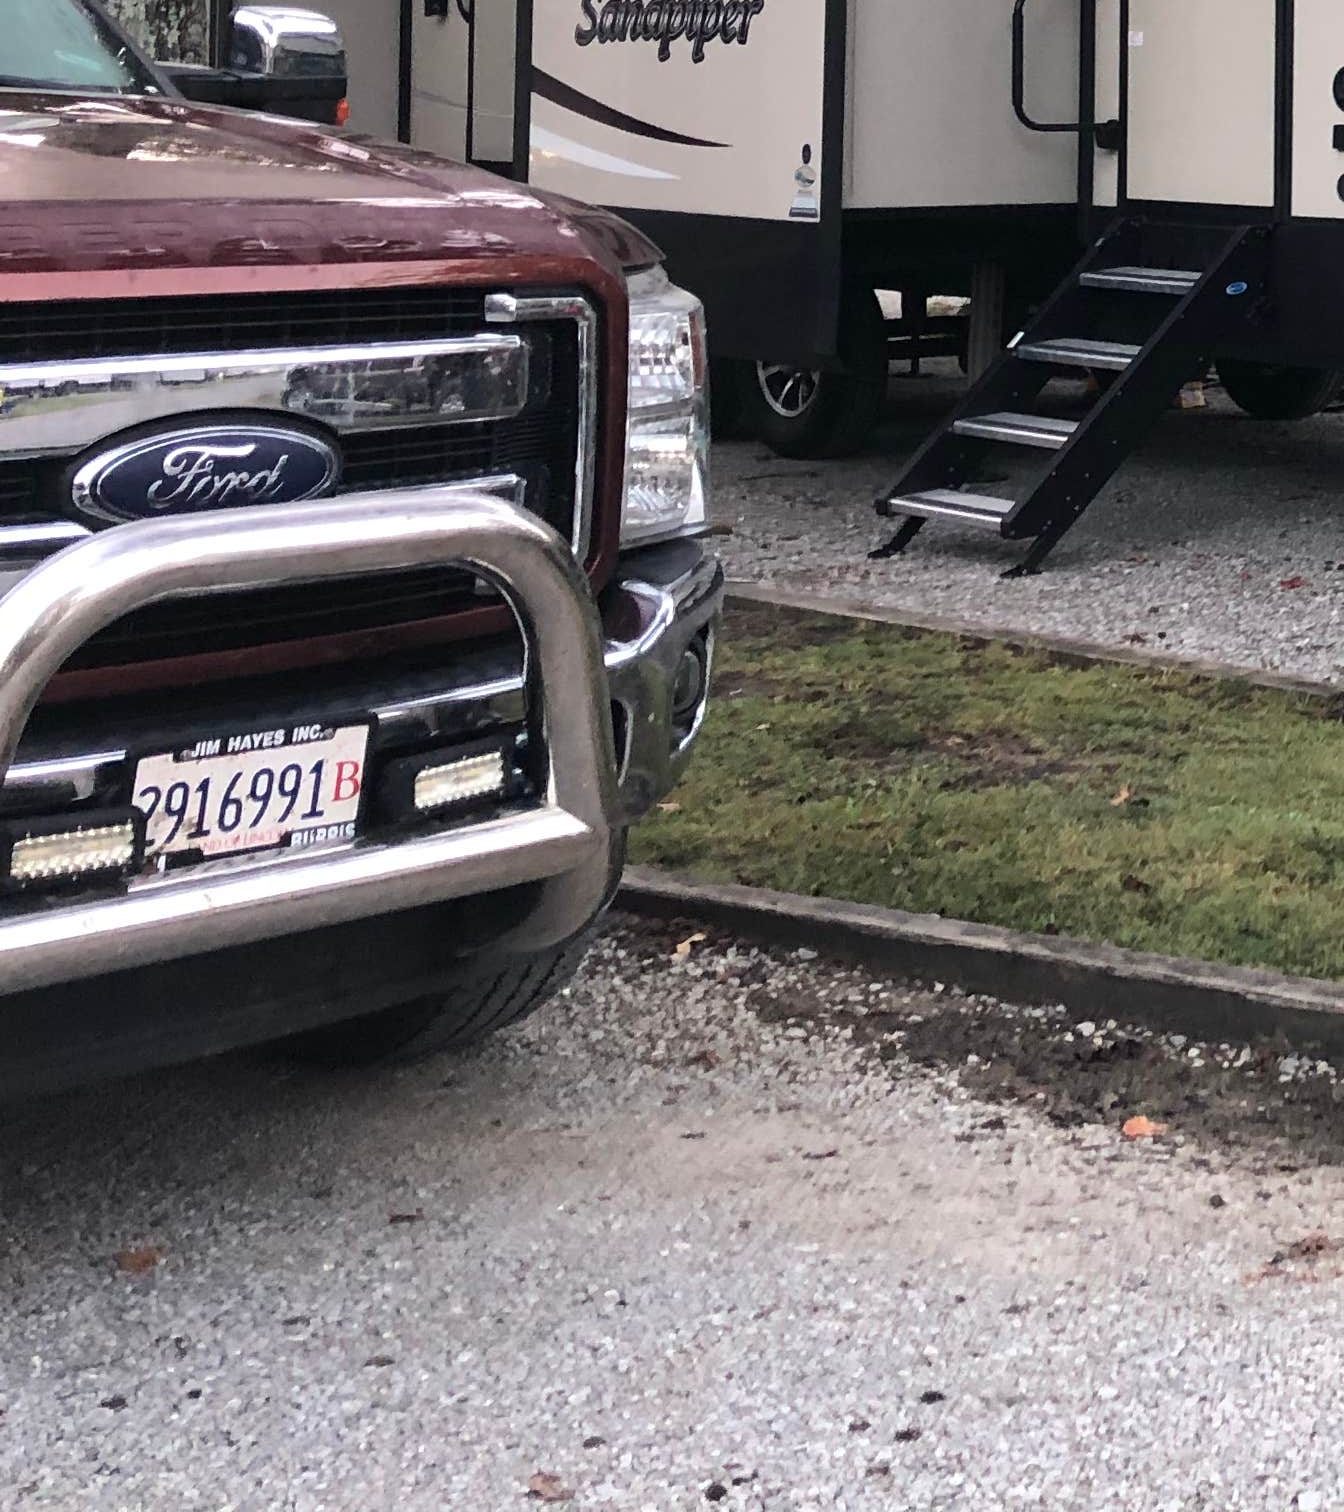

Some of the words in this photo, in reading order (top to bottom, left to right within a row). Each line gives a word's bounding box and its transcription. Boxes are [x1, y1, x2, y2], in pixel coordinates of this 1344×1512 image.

[146, 443, 289, 509] Ford
[191, 739, 221, 758] JIM
[227, 728, 285, 753] HAYES
[292, 723, 324, 743] INC.
[331, 760, 362, 803] B
